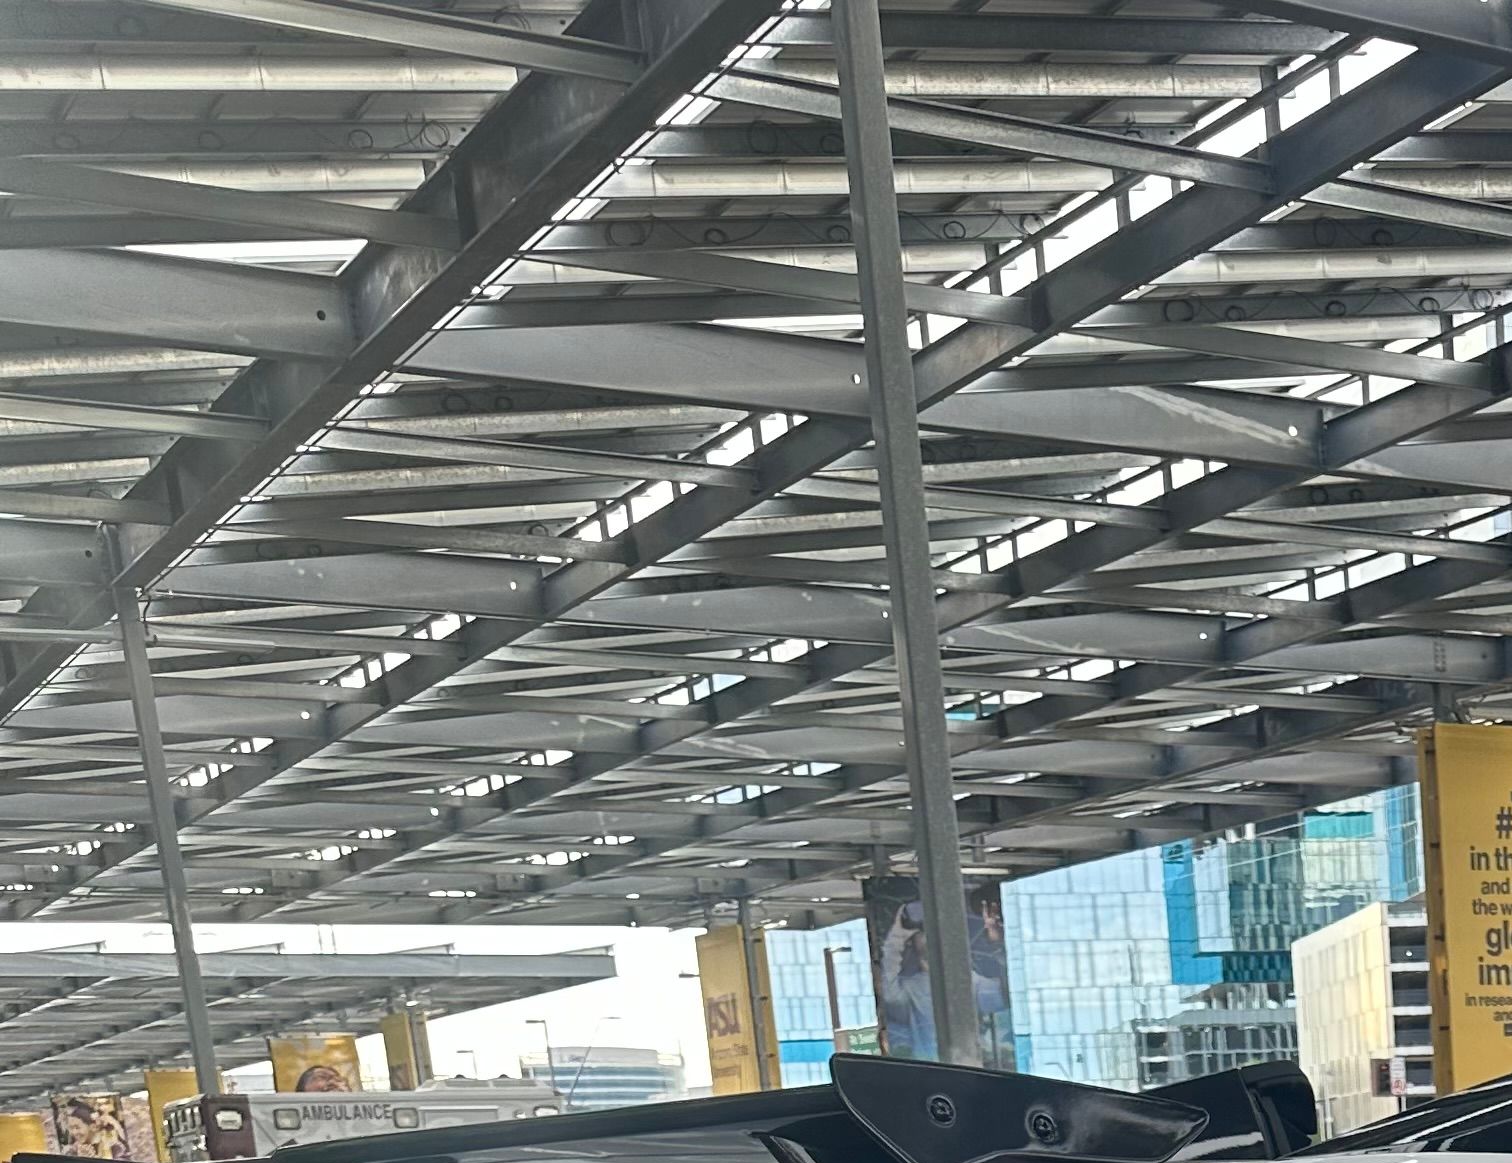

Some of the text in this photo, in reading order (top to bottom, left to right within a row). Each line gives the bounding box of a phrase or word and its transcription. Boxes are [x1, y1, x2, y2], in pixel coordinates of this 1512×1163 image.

[1469, 846, 1490, 871] in
[1481, 878, 1510, 895] and
[1472, 898, 1498, 916] the
[1464, 993, 1477, 1007] in
[302, 1104, 392, 1120] AMBULANCE
